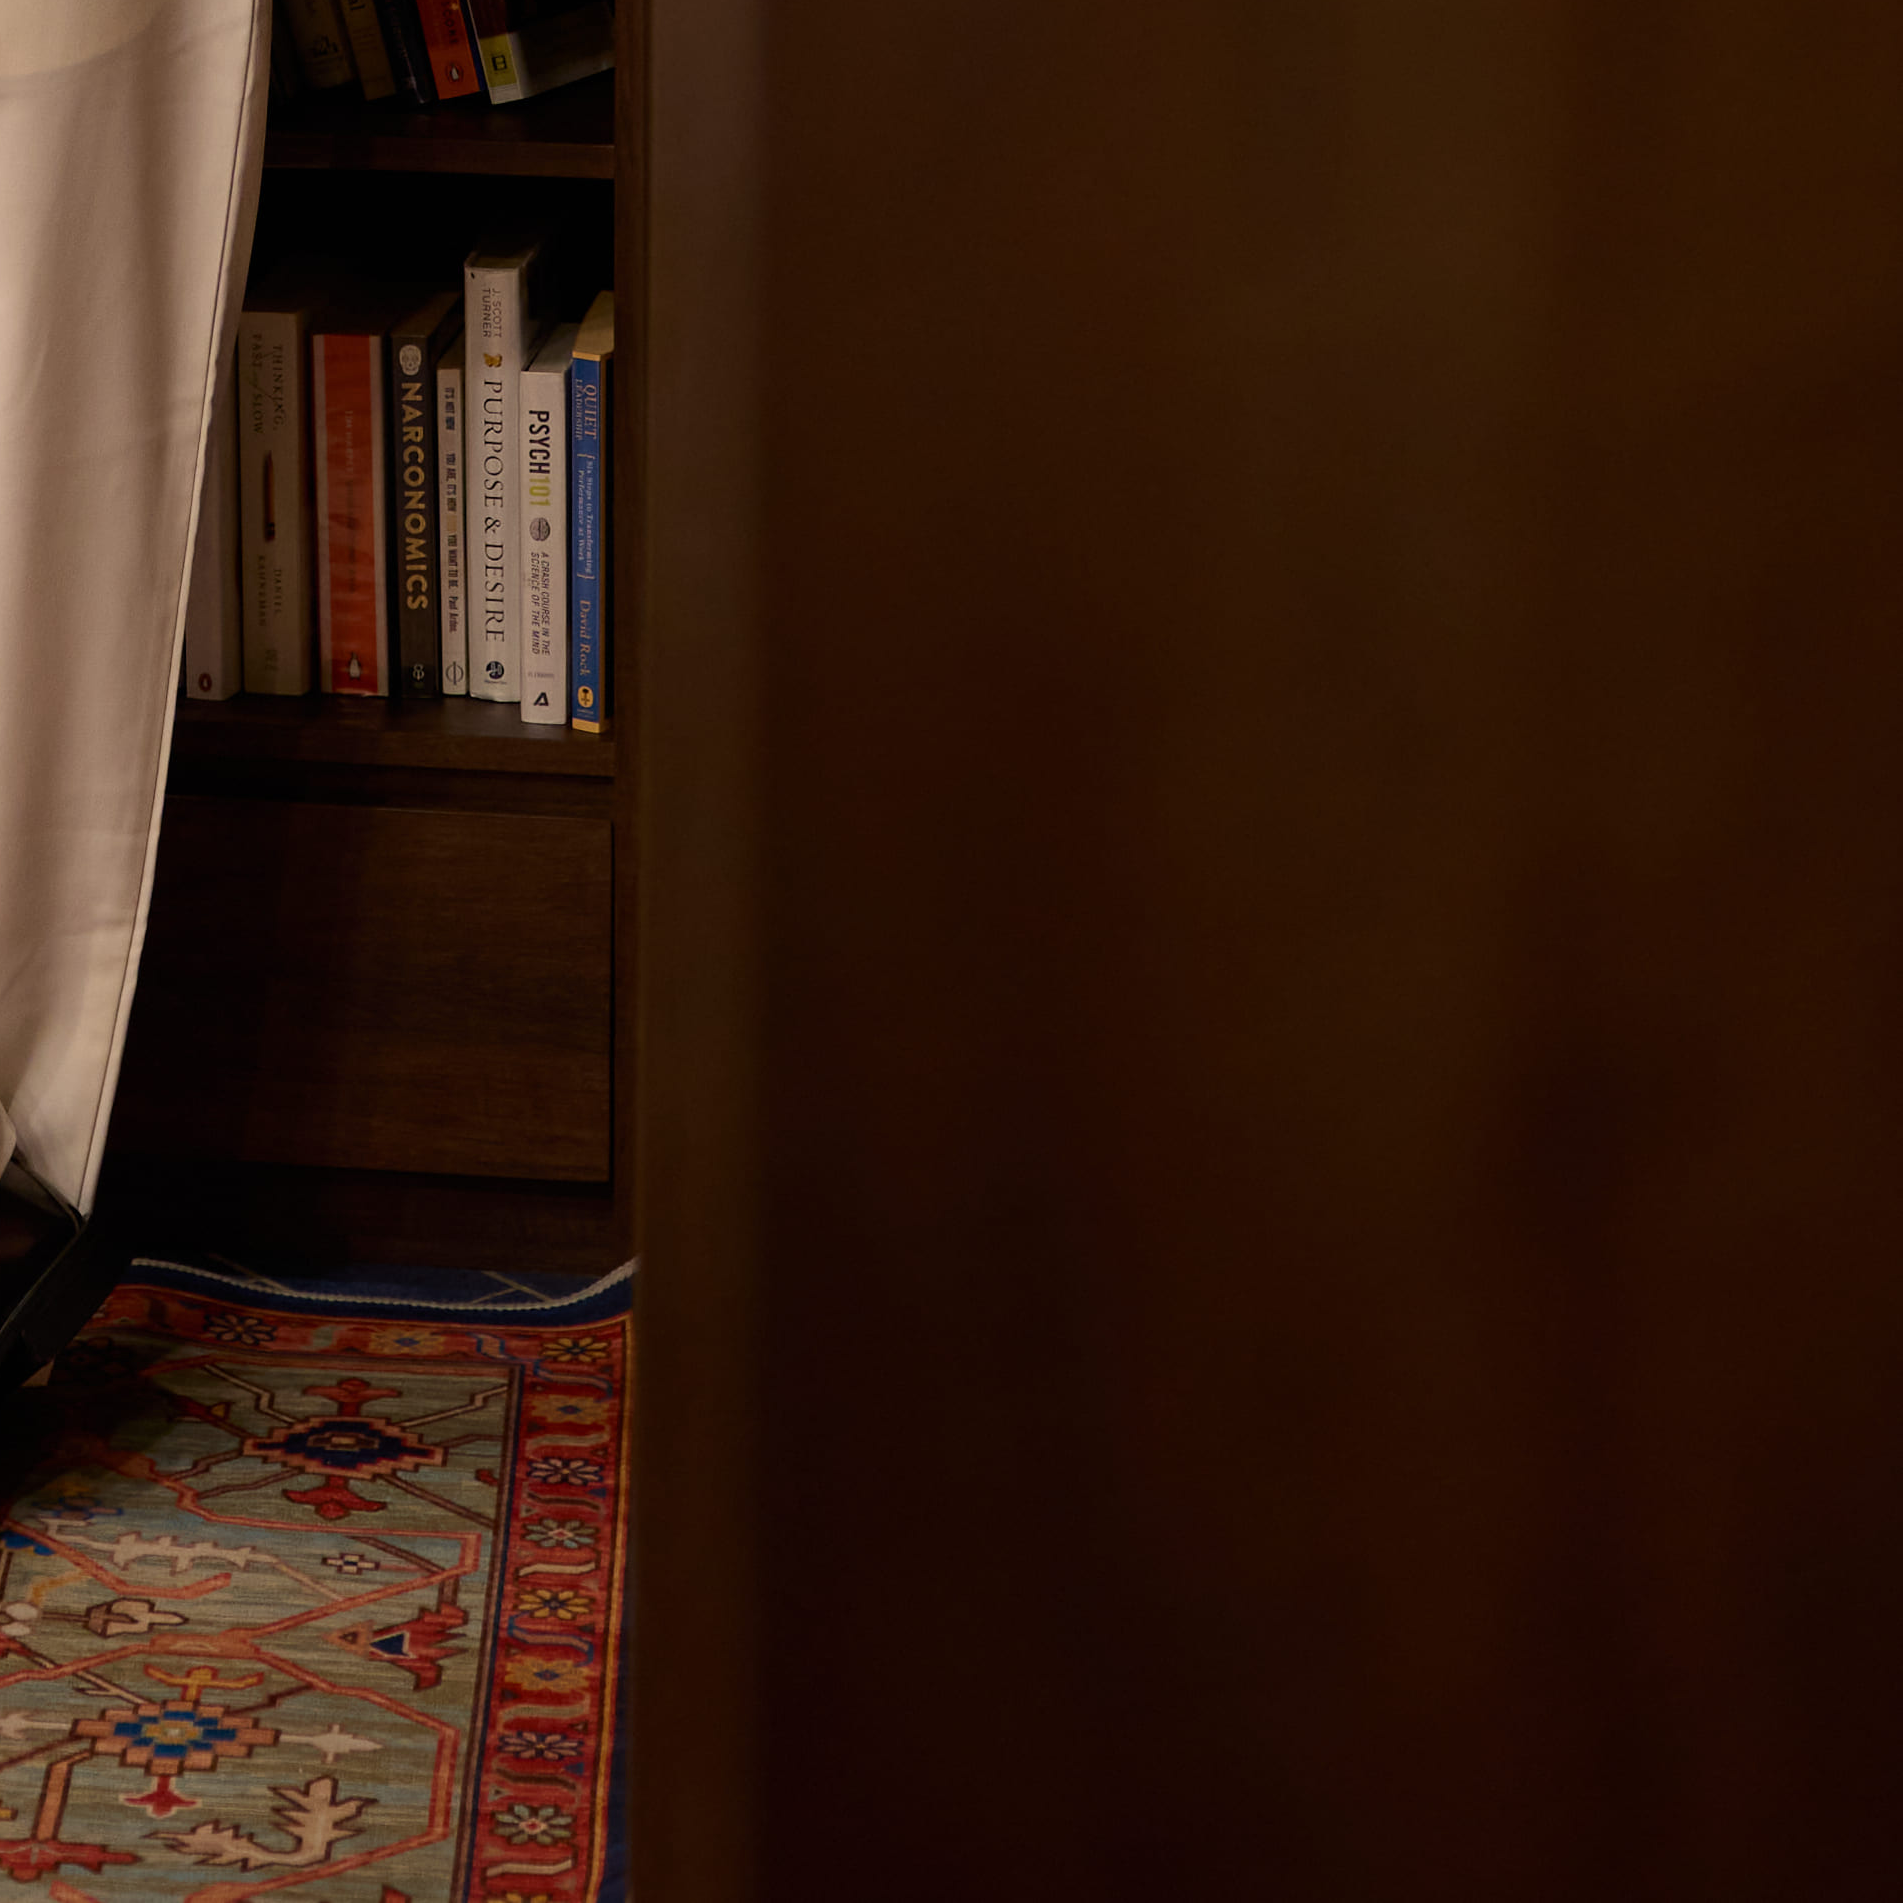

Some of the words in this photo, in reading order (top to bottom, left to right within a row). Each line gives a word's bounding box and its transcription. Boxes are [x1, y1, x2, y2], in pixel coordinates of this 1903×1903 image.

[401, 382, 428, 610] NARCONOMICS
[483, 380, 504, 508] PURPOSE
[485, 516, 501, 534] &
[485, 542, 505, 642] DESIRE
